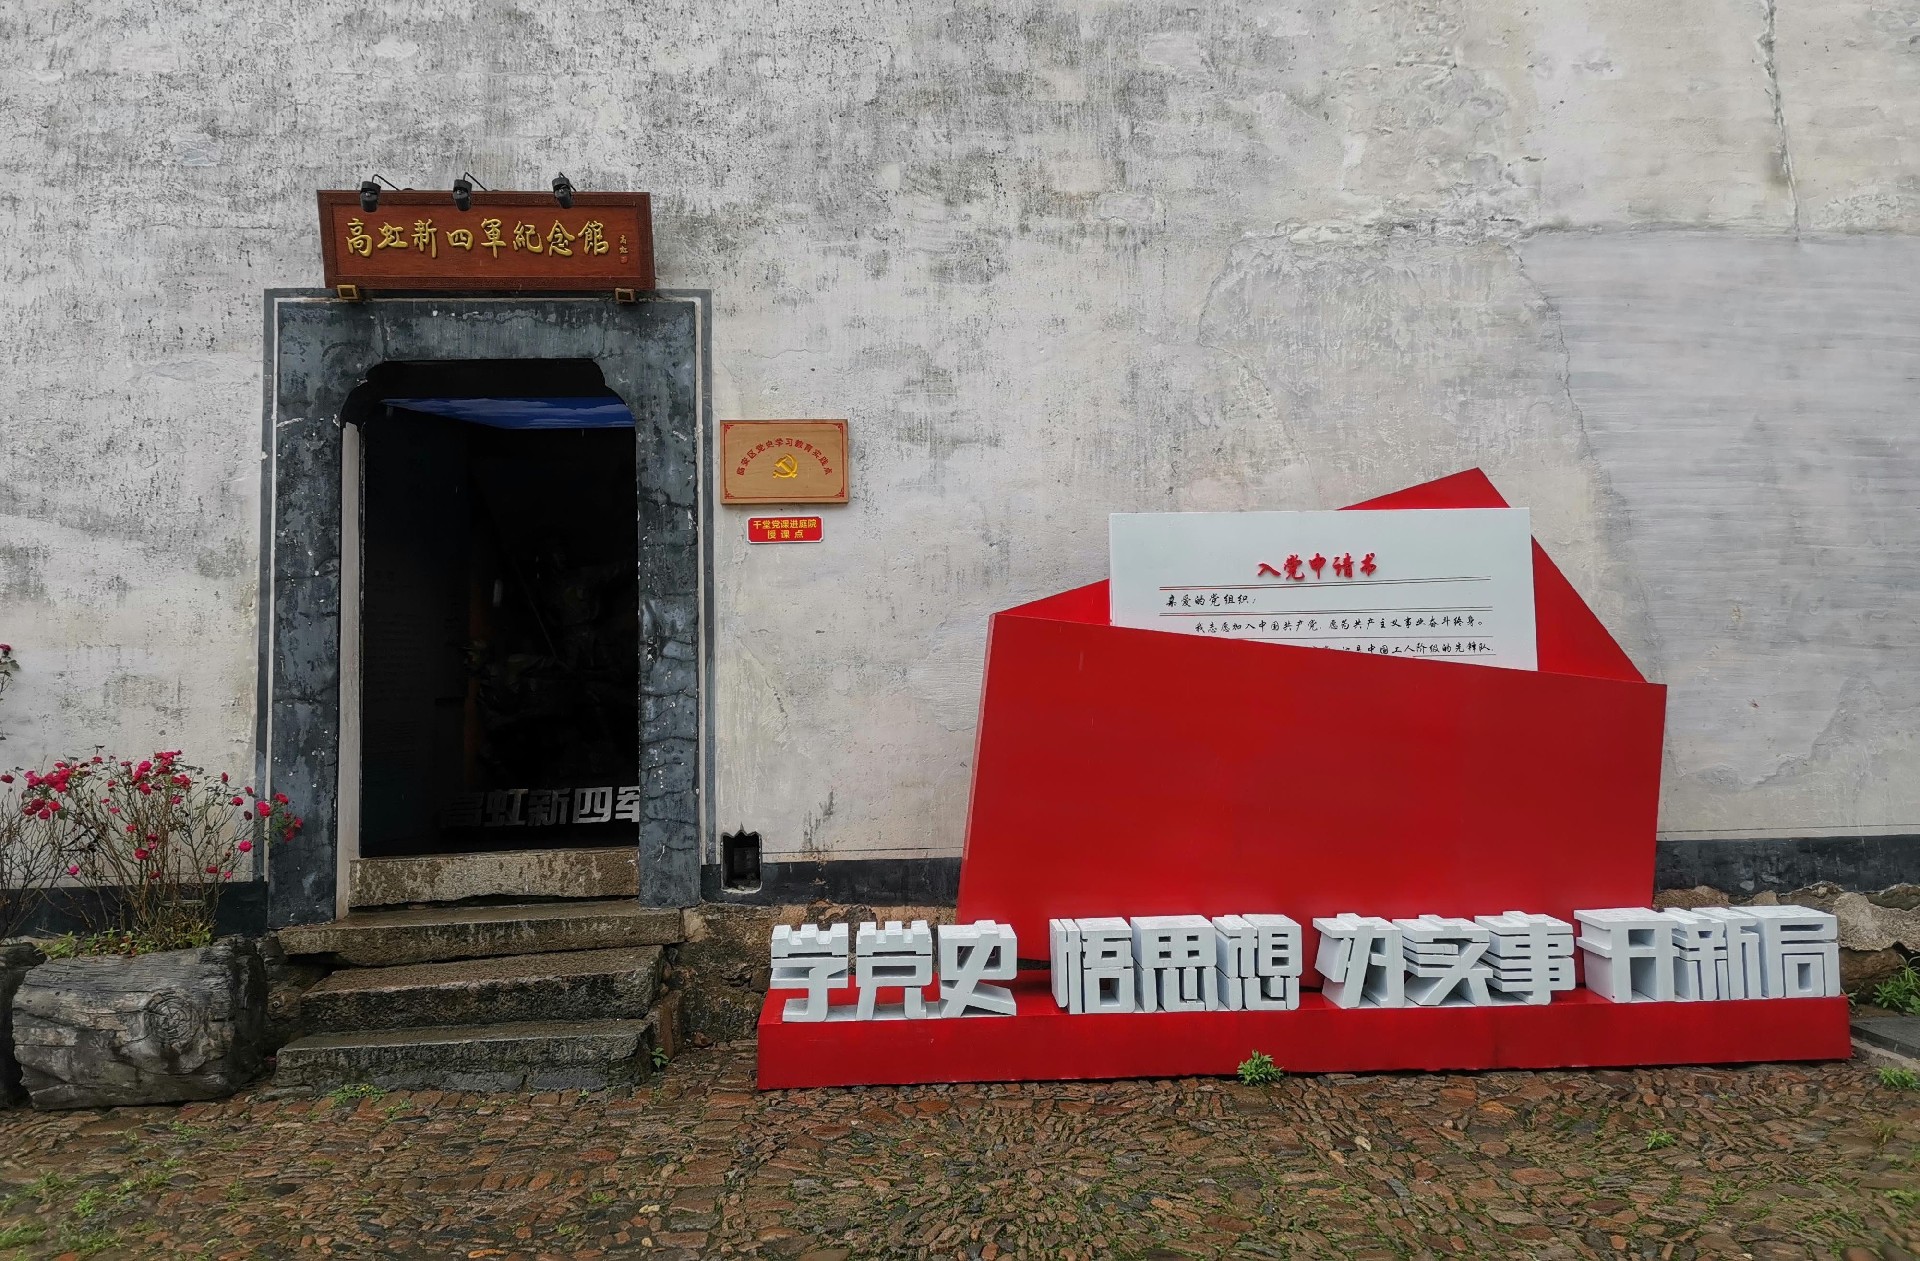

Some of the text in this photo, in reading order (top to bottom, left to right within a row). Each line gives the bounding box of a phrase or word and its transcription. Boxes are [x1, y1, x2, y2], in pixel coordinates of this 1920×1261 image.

[345, 218, 610, 259] 高虹新四軍紀念館
[736, 437, 833, 476] 临安区党史学习教育实践点
[752, 518, 817, 530] 千堂党课进庭院
[767, 529, 804, 540] 授课点
[1256, 552, 1379, 581] 入党申请书
[770, 905, 1839, 1023] 学党史 悟思想 办实事 开新局
